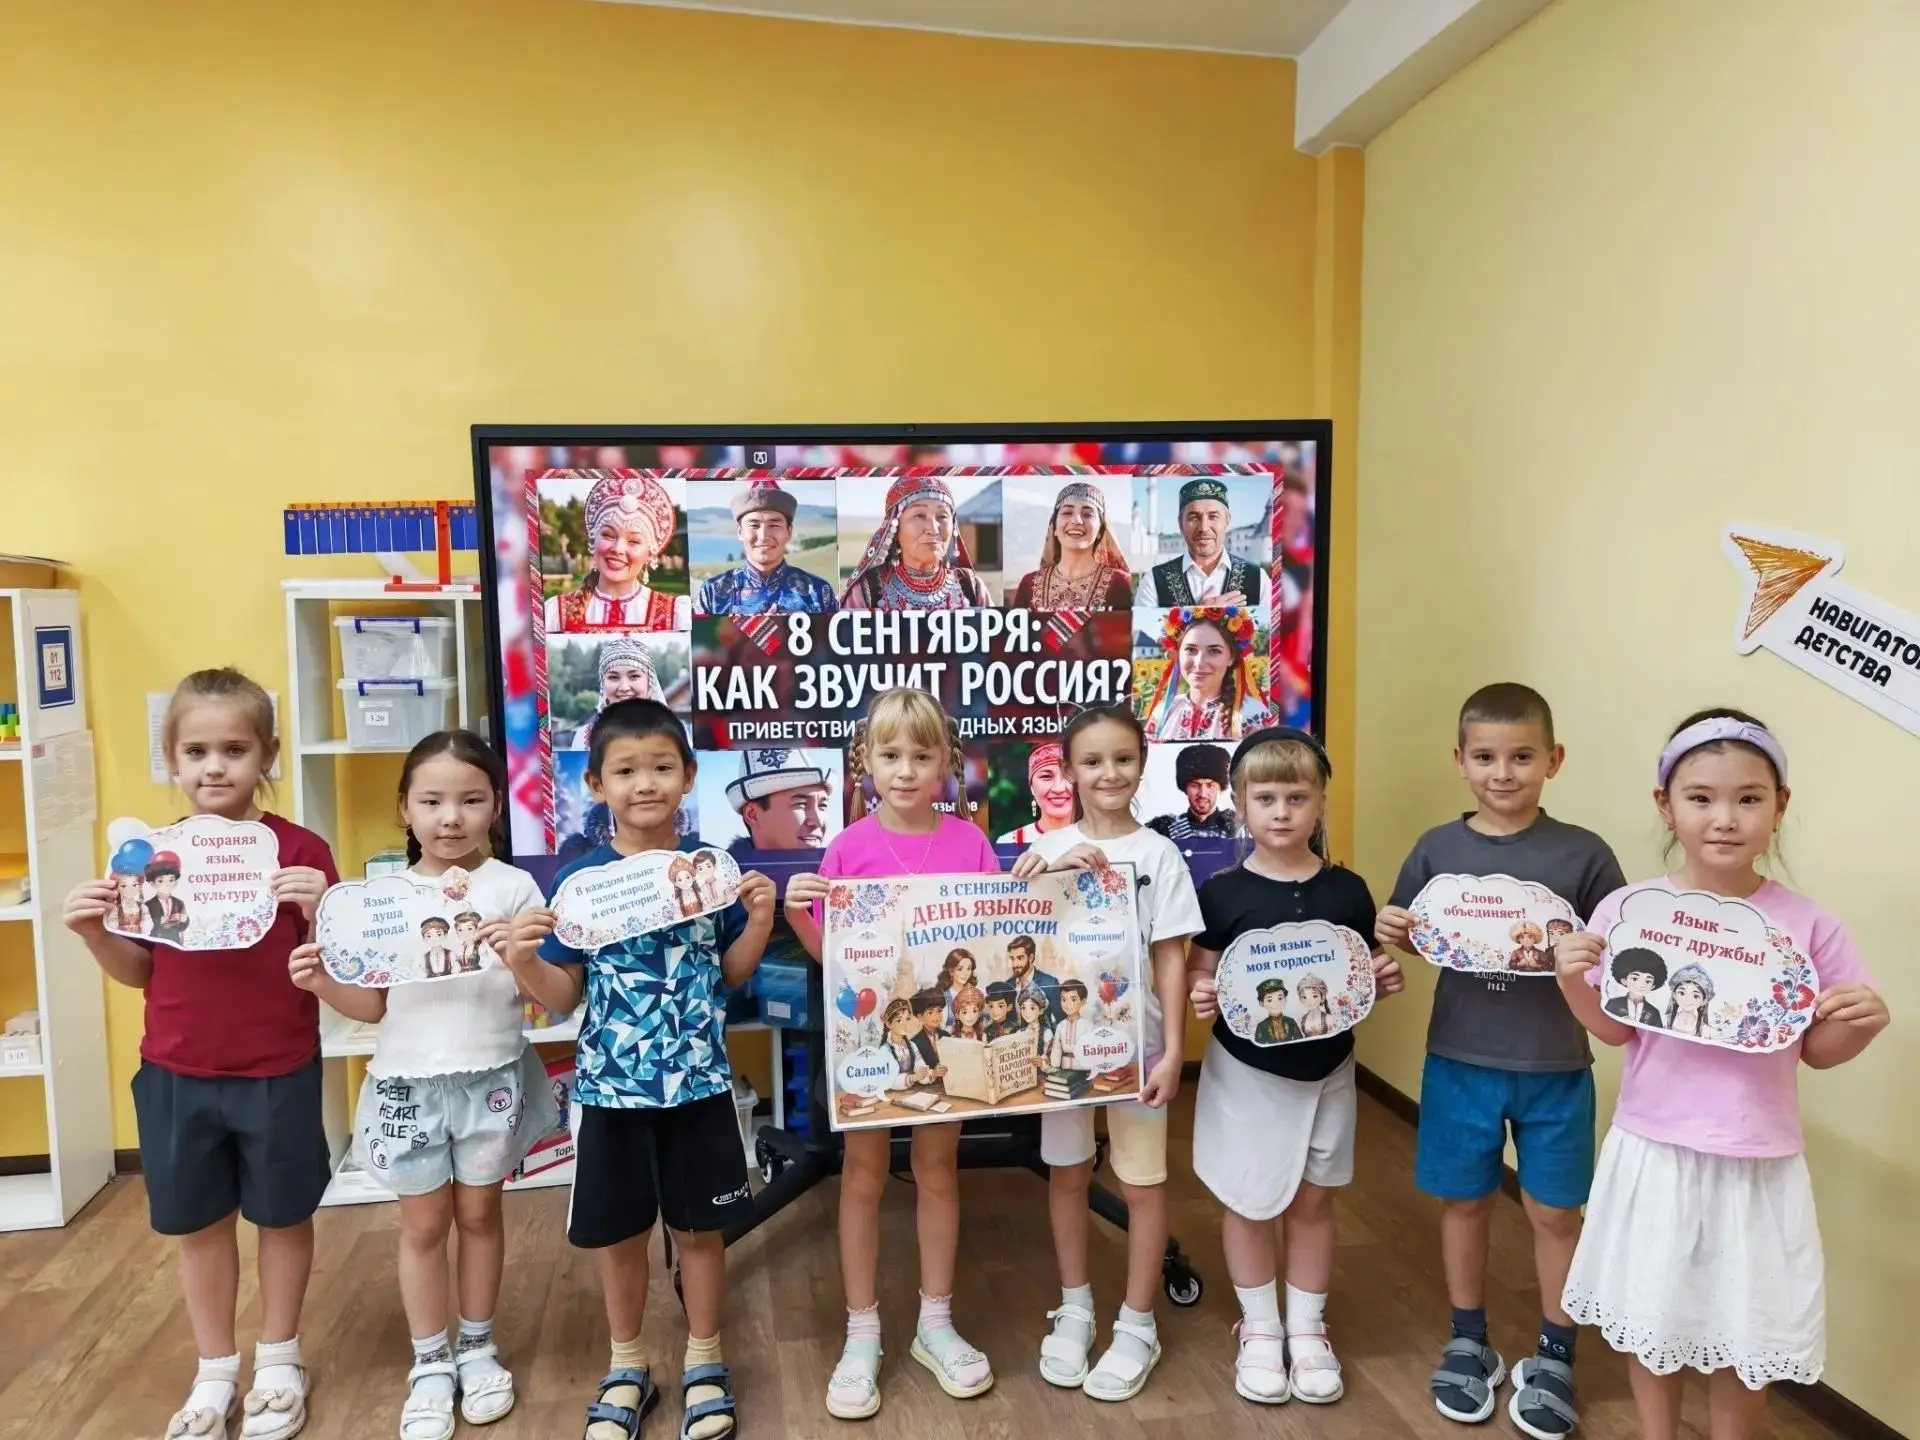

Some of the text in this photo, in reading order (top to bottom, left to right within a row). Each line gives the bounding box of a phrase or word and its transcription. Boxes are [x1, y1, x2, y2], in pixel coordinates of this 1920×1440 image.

[788, 608, 1042, 656] 8 СЕНТЯБРЯ:
[50, 652, 58, 663] 01
[1794, 625, 1892, 687] ДЕТСТВА
[50, 669, 61, 680] 112
[697, 665, 779, 710] КАК
[962, 659, 1131, 706] РОССИЯ?
[728, 716, 1067, 739] ПРИВЕТСТВИ ДНЫХ ЯЗЫ
[192, 834, 257, 848] Сохраняя
[206, 854, 245, 865] язык,
[188, 871, 262, 885] сохраняем
[575, 886, 583, 896] В
[585, 876, 624, 894] каждом
[626, 867, 655, 882] языке
[193, 890, 258, 904] культуру
[591, 881, 655, 906] голос народа
[939, 884, 949, 897] 8
[1461, 891, 1503, 905] Слово
[363, 896, 395, 908] Язык
[591, 890, 662, 920] и его история!
[372, 910, 403, 924] душа
[912, 898, 1053, 927] ДЕНЬ ЯЗЫКОВ
[1444, 905, 1526, 920] объединяет!
[362, 921, 409, 940] народа!
[993, 920, 1058, 936] РОССИИ
[1672, 910, 1719, 934] Язык
[844, 945, 894, 962] Привет!
[1250, 942, 1276, 956] Мой
[1280, 939, 1313, 952] язык
[1640, 928, 1766, 966] мост дружбы!
[1246, 949, 1336, 973] моя гордость!
[1000, 1046, 1031, 1063] ЯЗЫКИ
[846, 1062, 890, 1079] Салам!
[1000, 1067, 1032, 1083] РОССИИ
[379, 1101, 421, 1122] HEART
